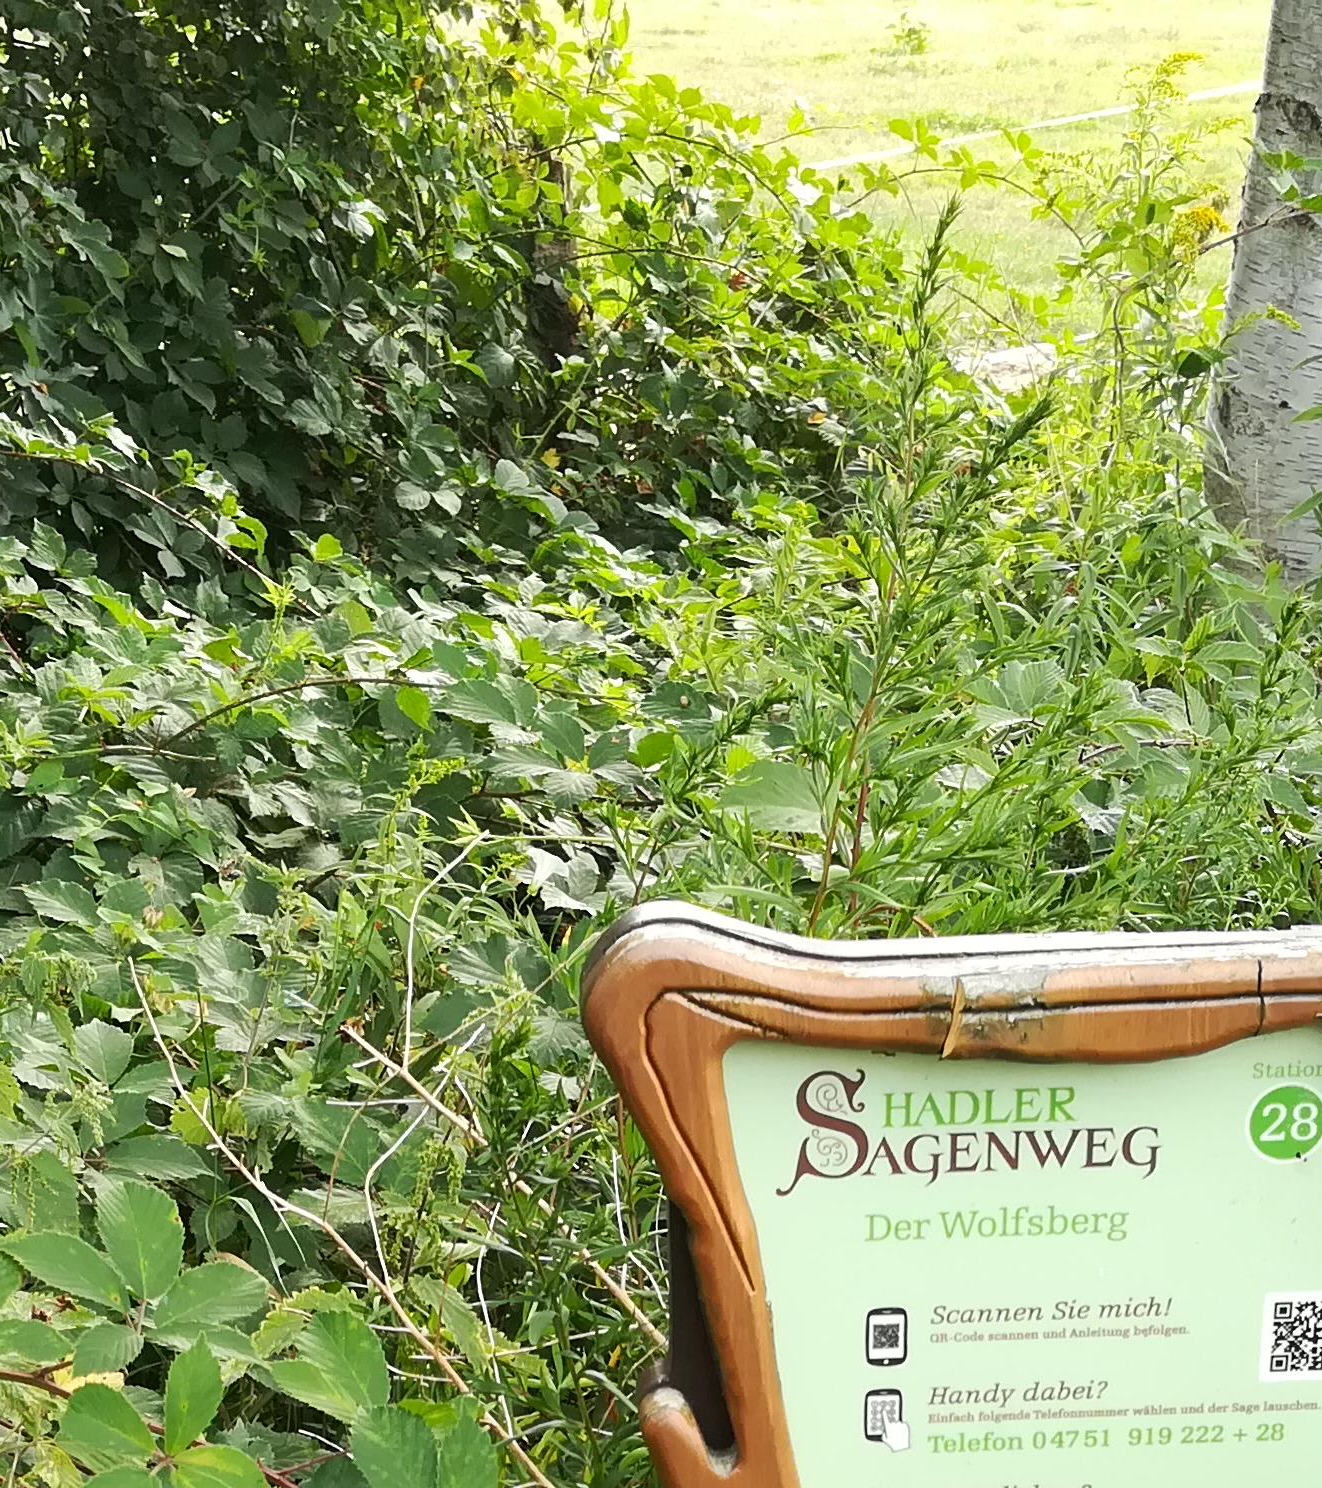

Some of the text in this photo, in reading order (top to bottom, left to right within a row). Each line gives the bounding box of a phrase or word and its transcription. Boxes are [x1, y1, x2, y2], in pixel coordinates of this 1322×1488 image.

[1259, 1102, 1319, 1141] 28
[864, 1205, 1130, 1242] Der Wolfsberg
[930, 1296, 1173, 1325] Scannen Sie mich!
[929, 1324, 1191, 1343] QR-Code scannen und Anleitung befolgen.
[927, 1380, 1109, 1408] Handy dabei?
[927, 1400, 1322, 1424] Einfach folgende Telefonnummer wählen und der Sage lauschen.
[927, 1431, 1024, 1453] Telefon
[1127, 1426, 1173, 1446] 919
[1180, 1424, 1224, 1445] 222
[1232, 1427, 1248, 1442] +
[1255, 1422, 1285, 1442] 28
